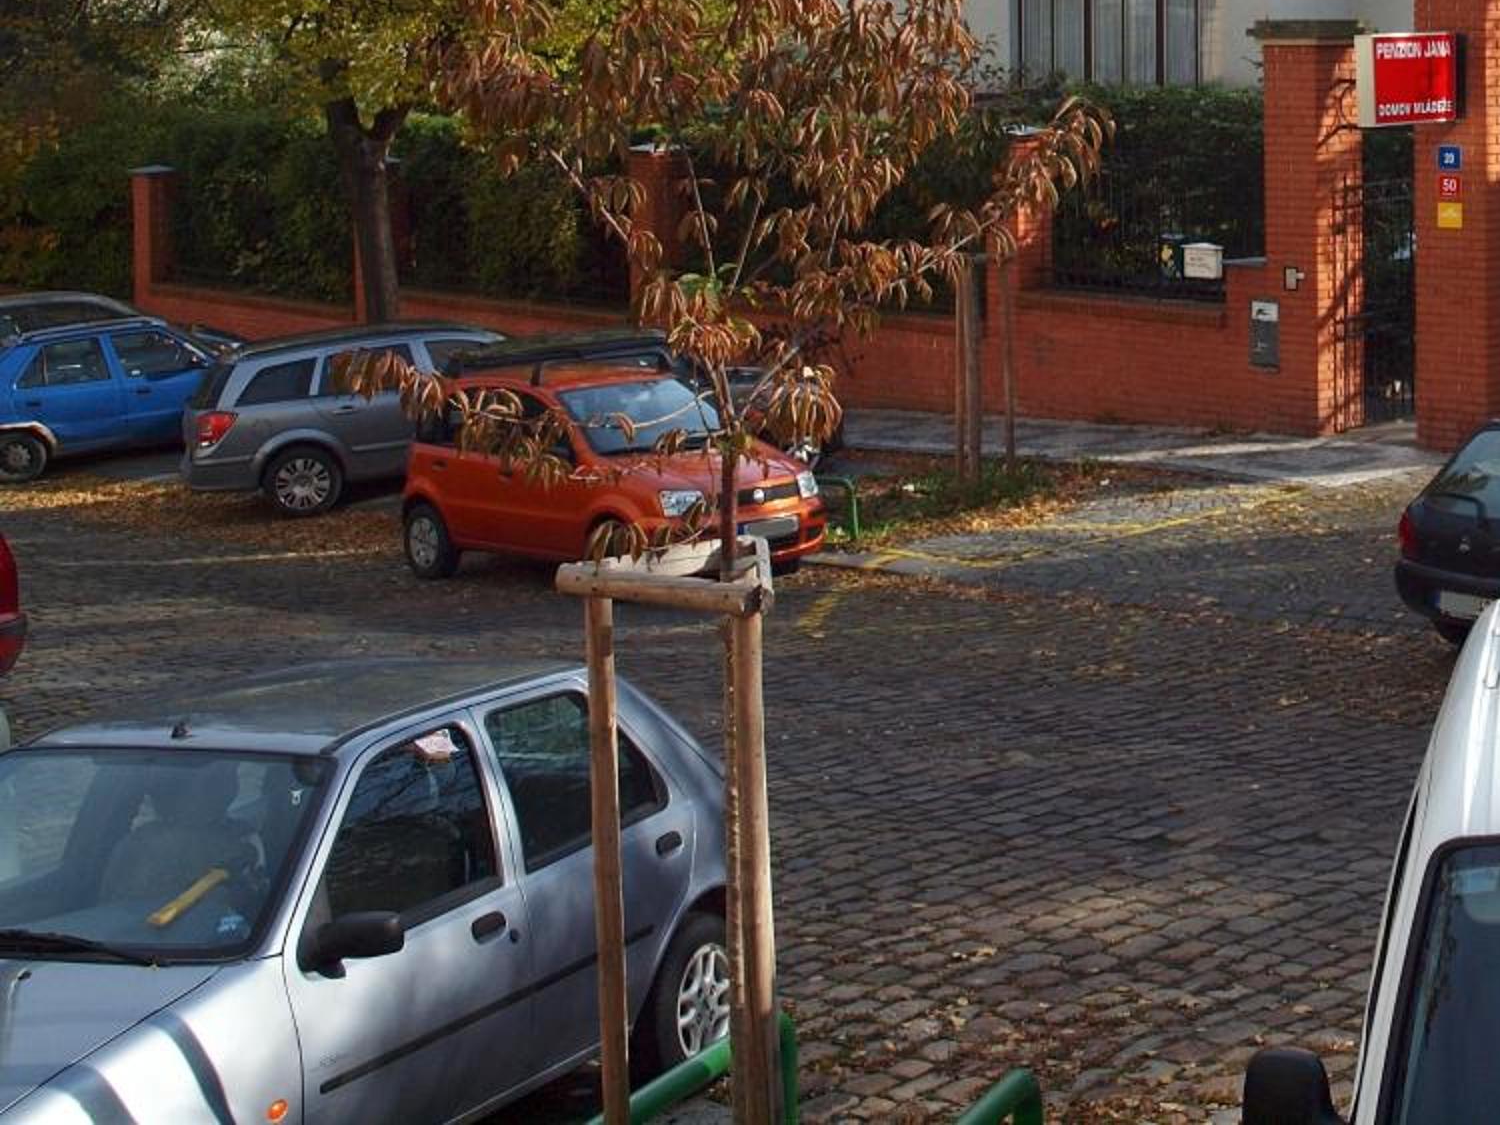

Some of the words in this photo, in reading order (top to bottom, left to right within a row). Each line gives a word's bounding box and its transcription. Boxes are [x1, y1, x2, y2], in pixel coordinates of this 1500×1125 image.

[1376, 41, 1422, 59] PENZION
[1378, 102, 1411, 116] DOMOV
[1442, 178, 1457, 192] 50
